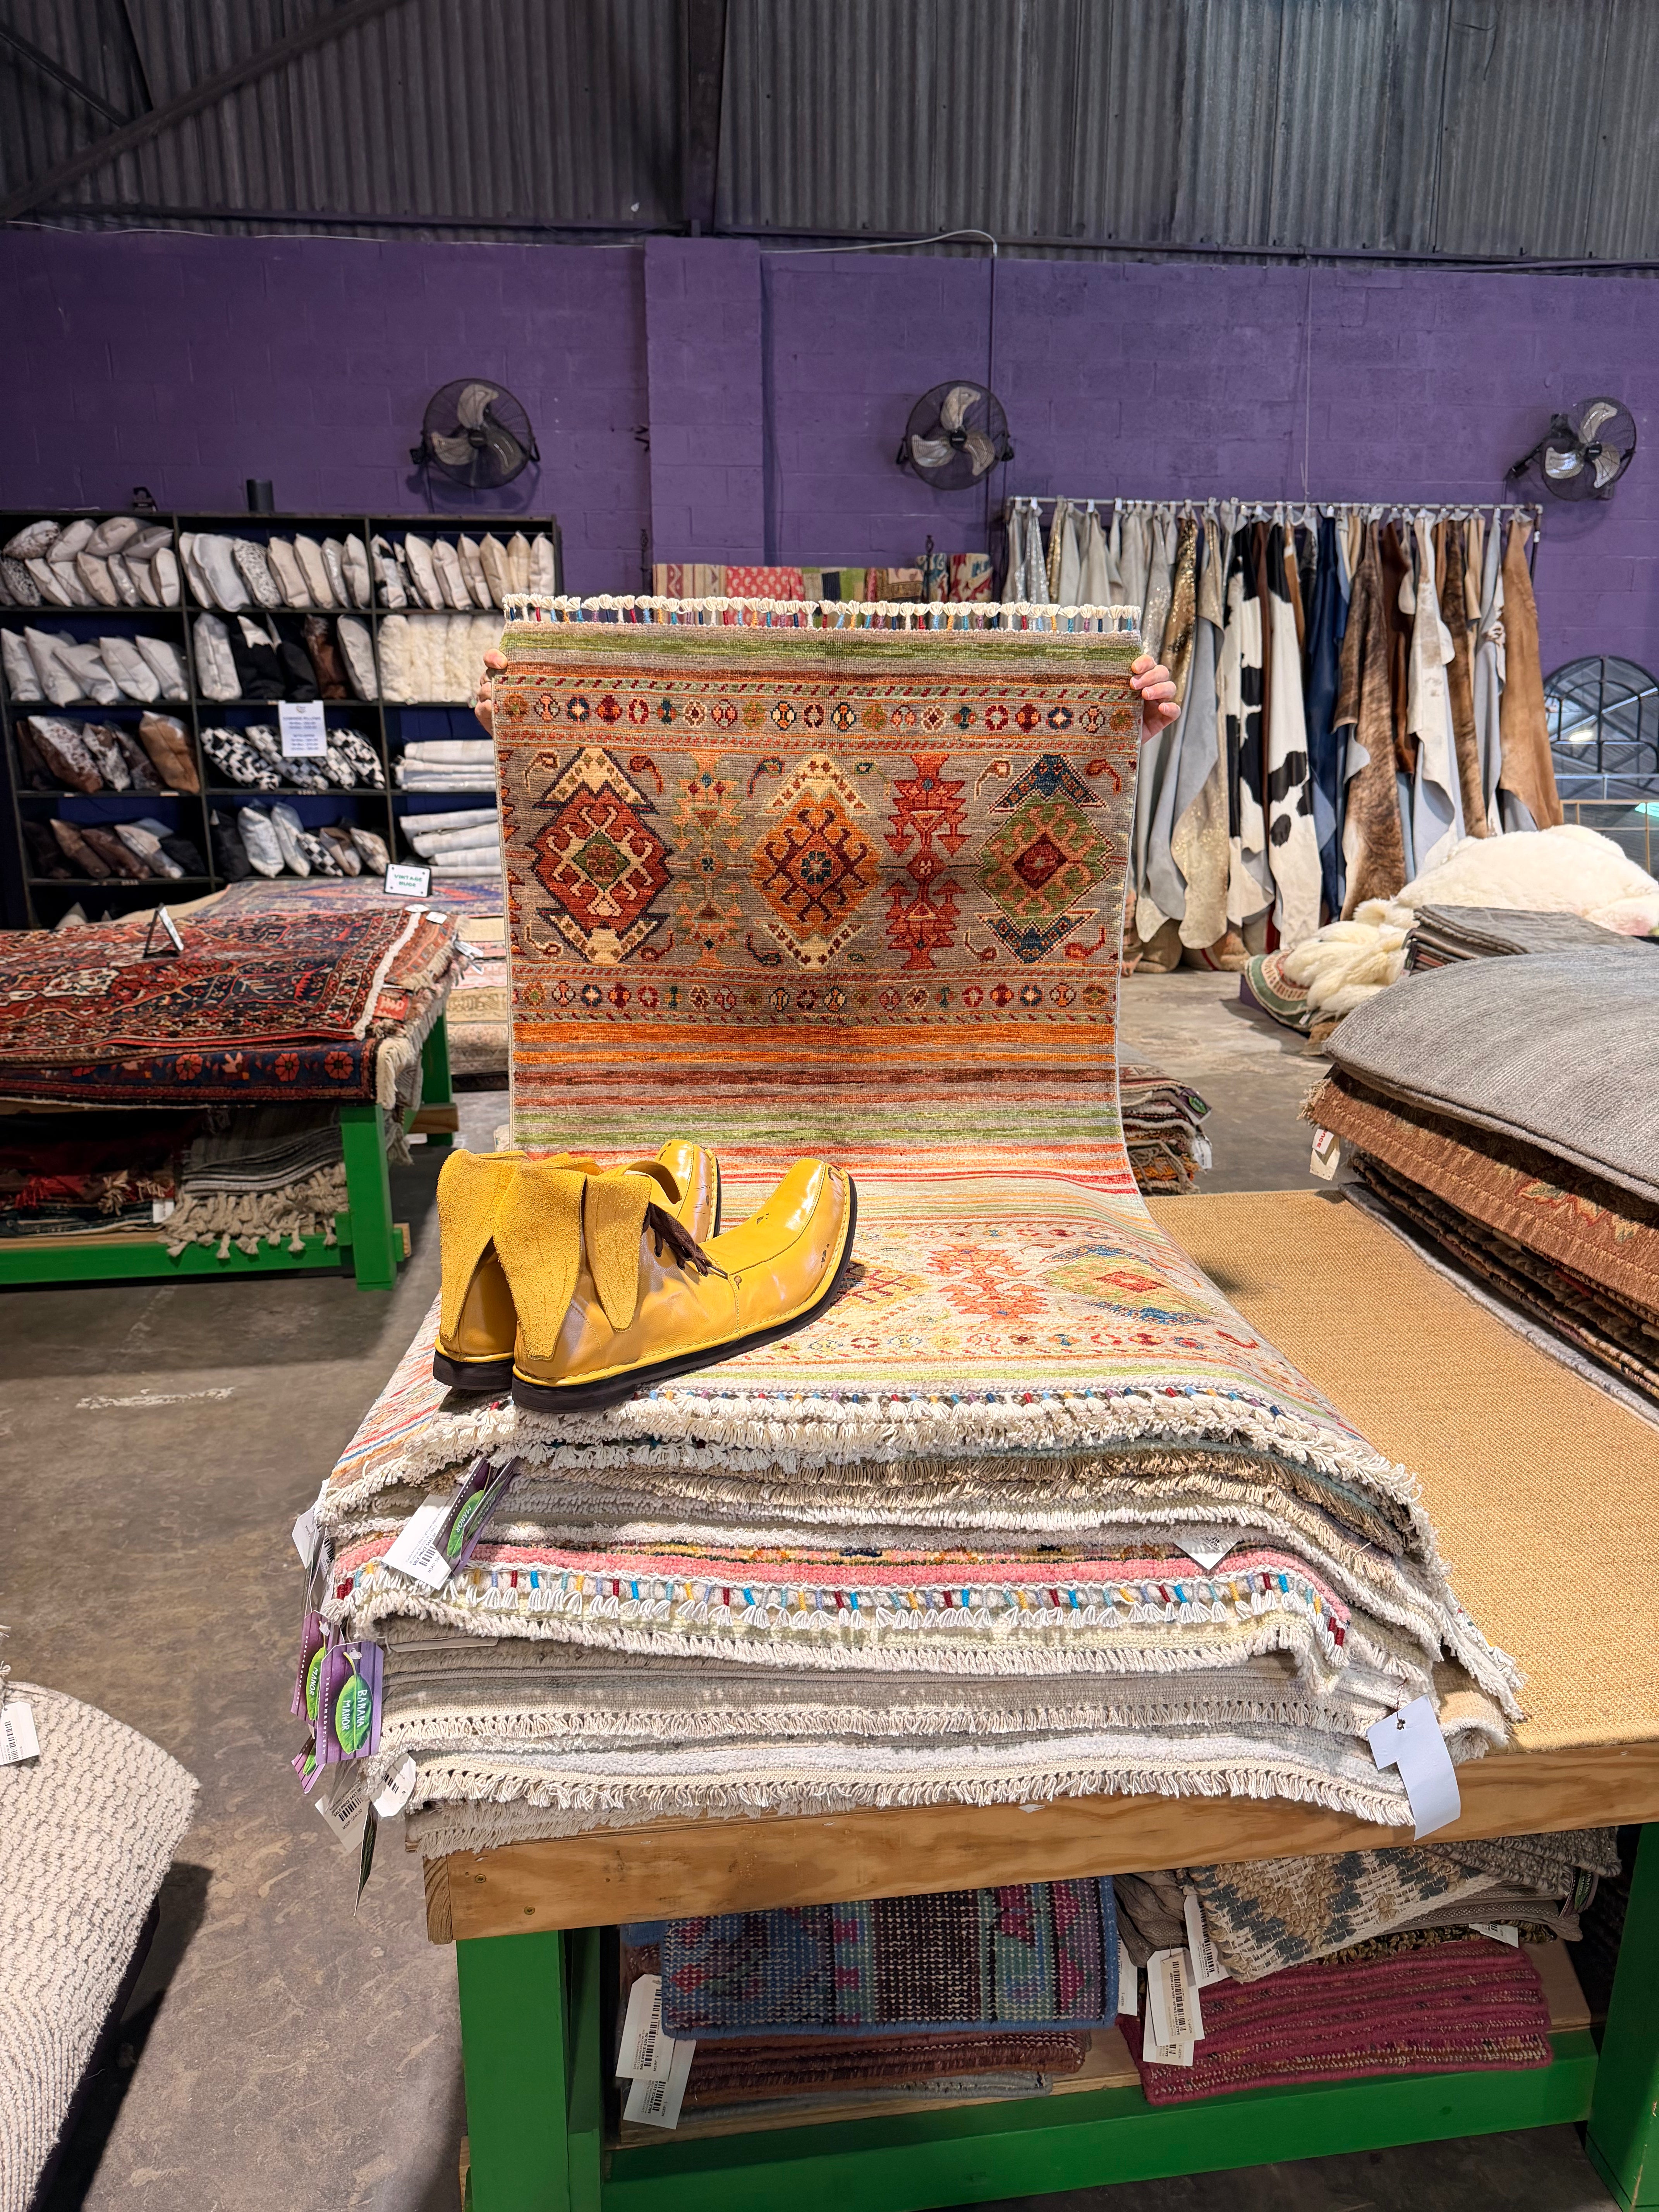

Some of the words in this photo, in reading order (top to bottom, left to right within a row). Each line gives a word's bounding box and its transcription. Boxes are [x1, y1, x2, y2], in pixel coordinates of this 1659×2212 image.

[394, 874, 422, 882] VINTAGE
[455, 1505, 472, 1533] MANOR
[412, 1556, 420, 1566] SALE
[418, 1546, 428, 1557] PRICE
[309, 1666, 318, 1697] MANOR
[322, 1677, 330, 1755] bananamanor.com
[341, 1700, 350, 1731] MANOR
[357, 1689, 368, 1728] BANANA
[333, 1808, 342, 1817] SALE
[340, 1799, 350, 1809] PRICE
